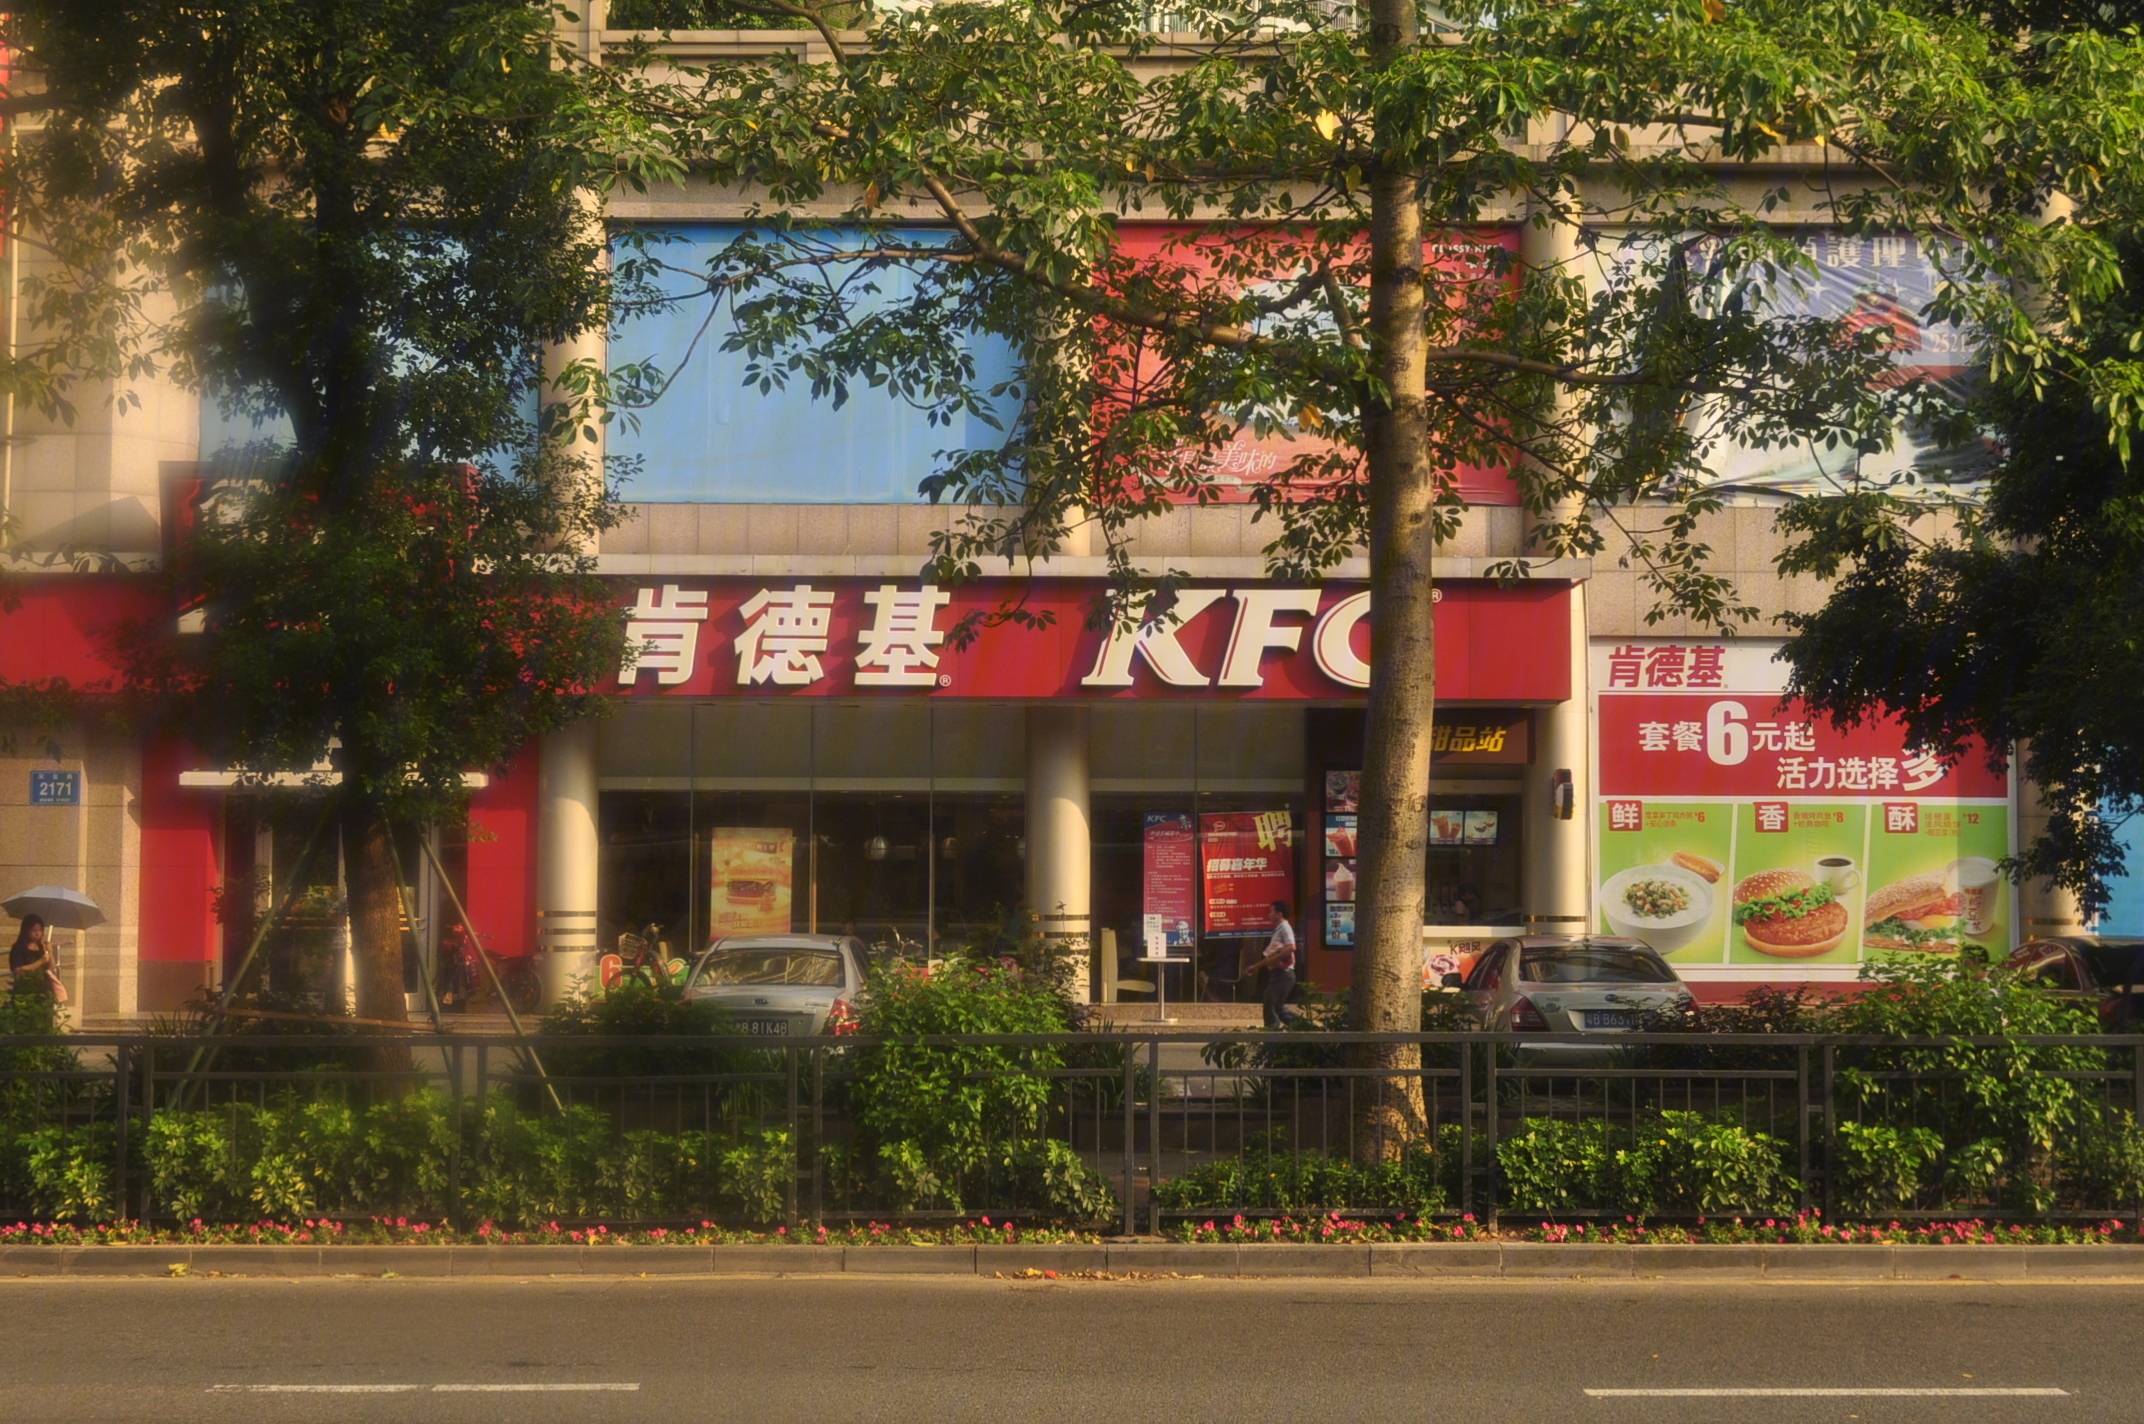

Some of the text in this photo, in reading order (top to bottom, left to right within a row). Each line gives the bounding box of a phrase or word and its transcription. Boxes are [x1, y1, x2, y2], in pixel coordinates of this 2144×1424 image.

[618, 584, 950, 686] 肯德基
[1609, 645, 1725, 688] 肯德基
[1638, 700, 1816, 766] 套餐6元起
[1777, 746, 1945, 792] 活力选择多
[40, 782, 72, 796] 2171
[1612, 803, 1640, 829] 鲜
[1759, 804, 1786, 830] 香
[1888, 806, 1916, 831] 酥
